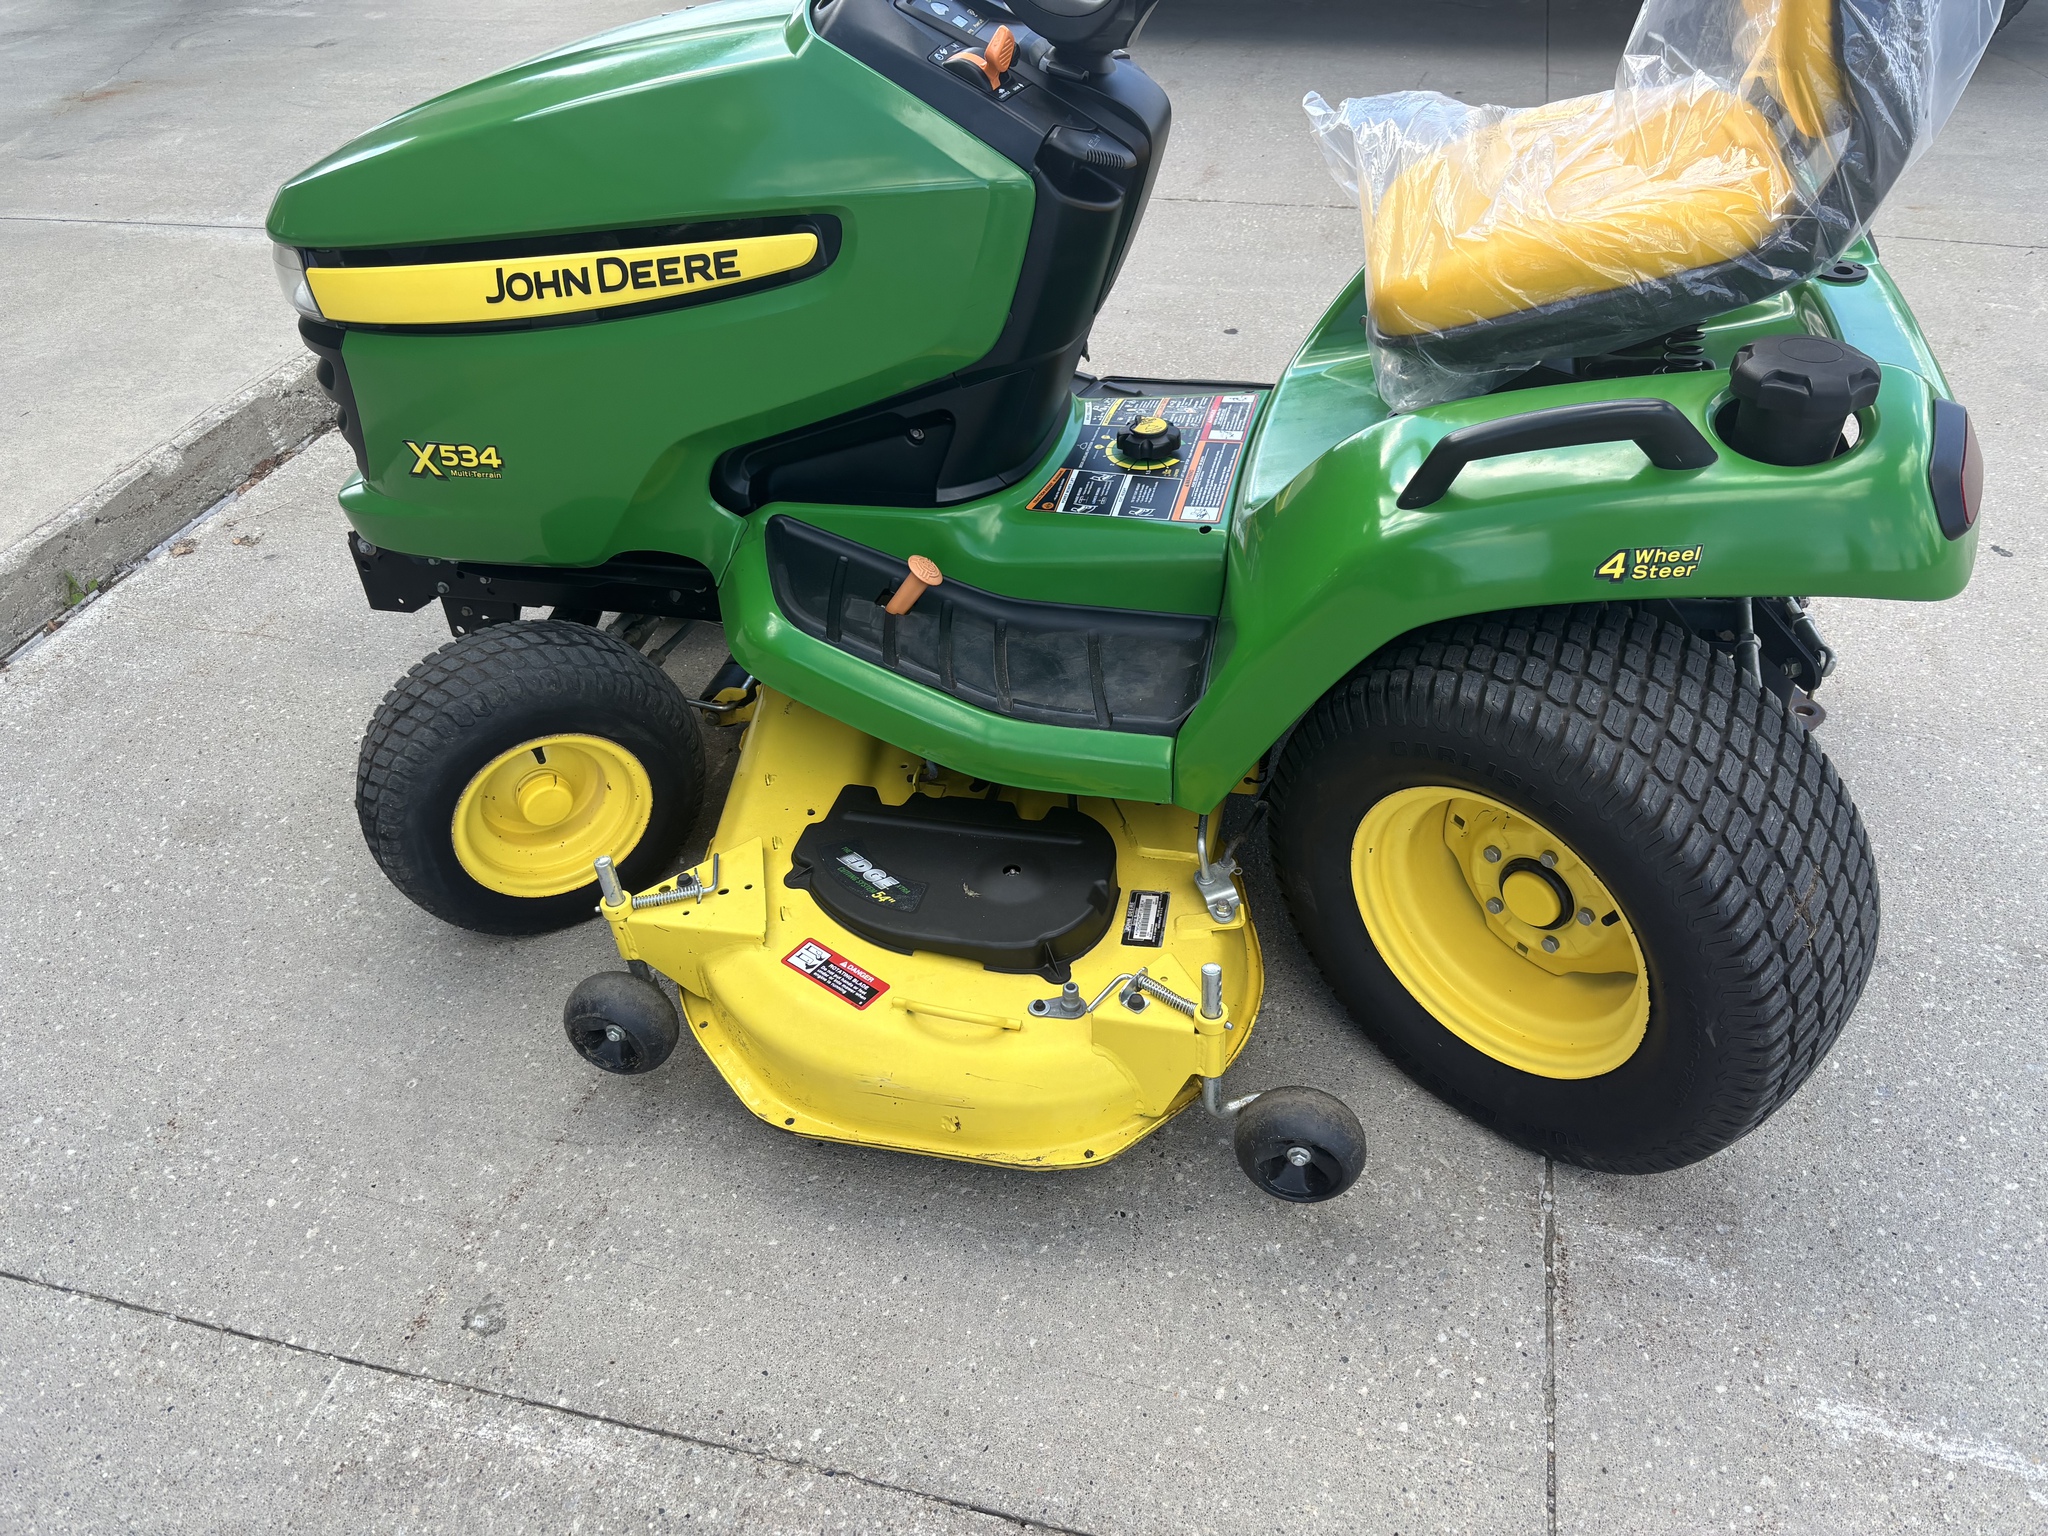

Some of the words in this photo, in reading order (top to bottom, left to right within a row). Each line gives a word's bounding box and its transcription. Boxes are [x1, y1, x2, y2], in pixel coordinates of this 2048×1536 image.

[486, 267, 592, 304] JOHN
[596, 249, 741, 294] DEERE
[404, 441, 502, 477] X534
[450, 469, 502, 479] Multi-Terrain
[1598, 552, 1626, 579] 4
[1635, 545, 1701, 564] Wheel
[1631, 564, 1697, 579] Steer
[1390, 740, 1575, 823] CARLISLE
[836, 851, 900, 890] EDGE
[855, 879, 878, 894] SYSTEM
[813, 972, 827, 982] engine
[831, 981, 847, 995] running
[828, 963, 853, 981] ROTATING
[852, 977, 869, 990] BLADE
[833, 972, 841, 980] put
[840, 977, 853, 988] hands
[847, 964, 875, 983] DANGER
[841, 983, 856, 994] mower
[855, 991, 867, 1000] when
